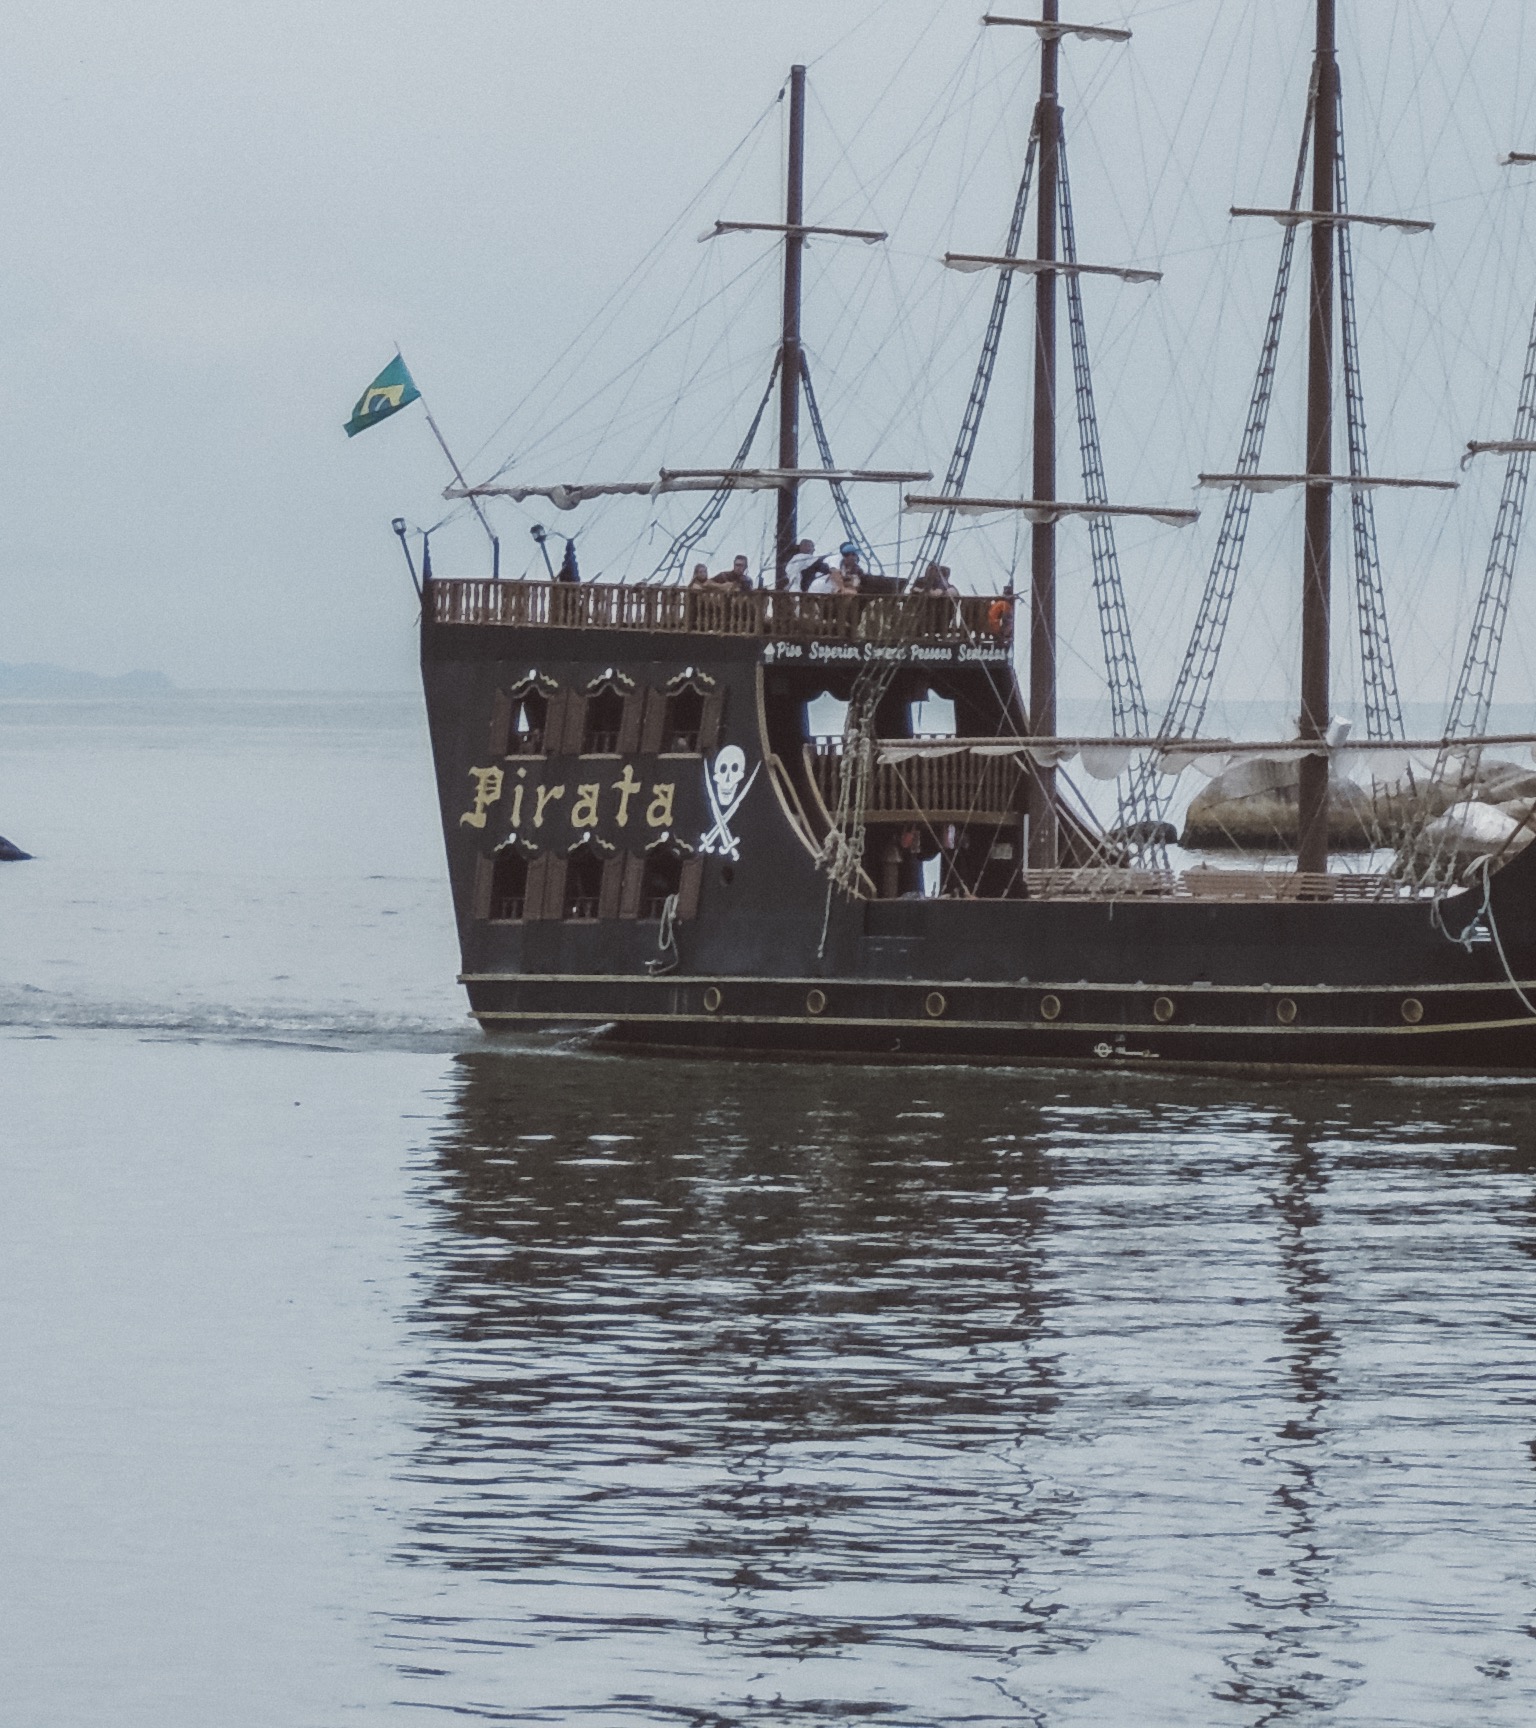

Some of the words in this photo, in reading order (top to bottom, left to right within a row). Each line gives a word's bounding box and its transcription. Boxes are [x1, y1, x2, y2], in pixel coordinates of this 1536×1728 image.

[776, 641, 803, 659] Piso
[808, 641, 861, 663] Superior
[459, 764, 675, 828] Pirata
